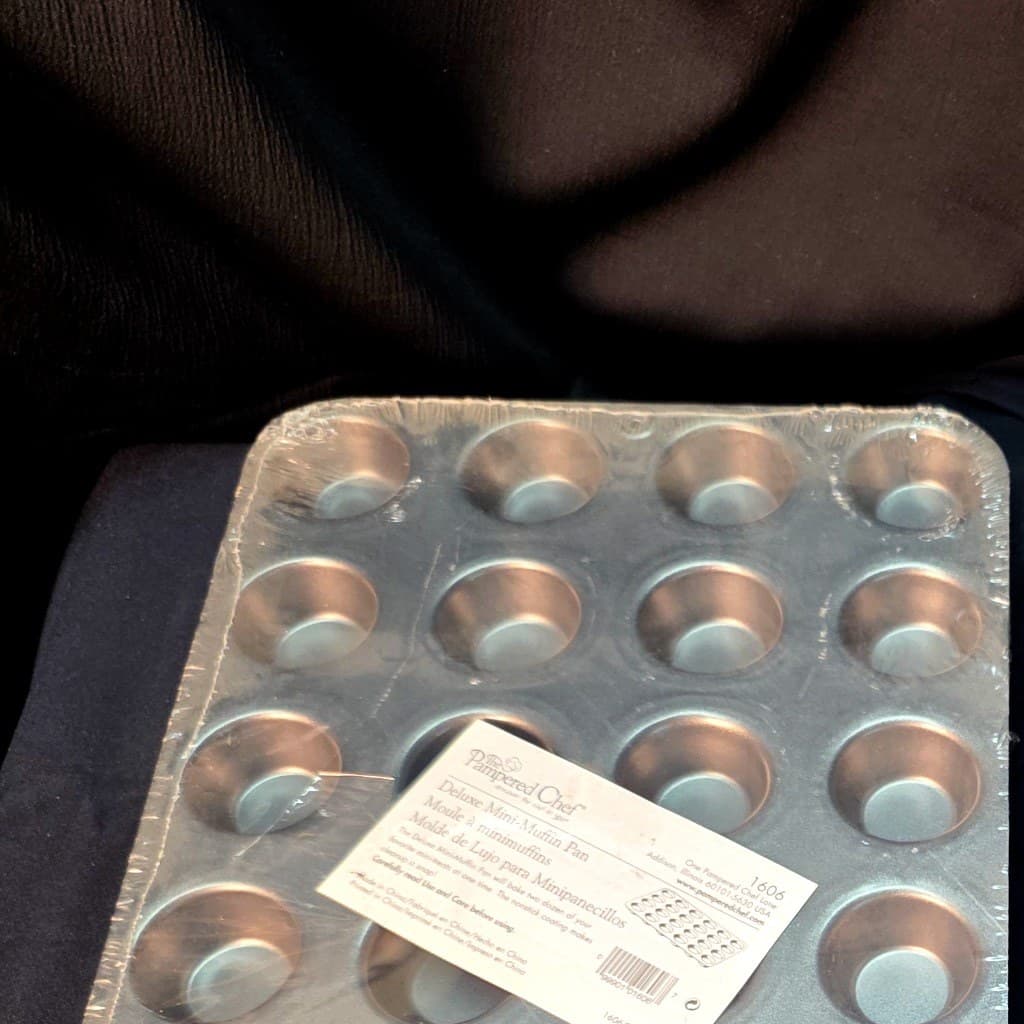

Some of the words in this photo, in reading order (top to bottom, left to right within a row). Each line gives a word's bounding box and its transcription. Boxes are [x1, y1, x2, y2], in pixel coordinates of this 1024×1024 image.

[457, 746, 543, 799] Pampered
[532, 782, 587, 819] Chef
[421, 792, 470, 823] Moule
[474, 819, 557, 867] minimuffins
[436, 777, 488, 809] Deluxe
[482, 800, 567, 849] Mini-Muffin
[561, 839, 595, 862] Pan
[368, 852, 407, 877] Carefully
[402, 869, 424, 884] read
[419, 878, 439, 892] Use
[433, 885, 454, 899] and
[448, 893, 473, 910] Care
[467, 903, 497, 922] before
[406, 809, 454, 839] Molde
[464, 839, 506, 867] Lujo
[497, 859, 532, 882] para
[527, 870, 632, 931] Minipanecillos
[494, 888, 513, 901] The
[683, 857, 704, 872] One
[738, 885, 761, 901] Chef
[758, 895, 779, 910] Lane
[747, 875, 789, 902] 1606
[504, 879, 528, 895] bake
[539, 897, 567, 915] dozen
[672, 876, 768, 928] www.pamperedchef.com
[702, 879, 755, 909] 60101-5630
[751, 904, 773, 919] USA
